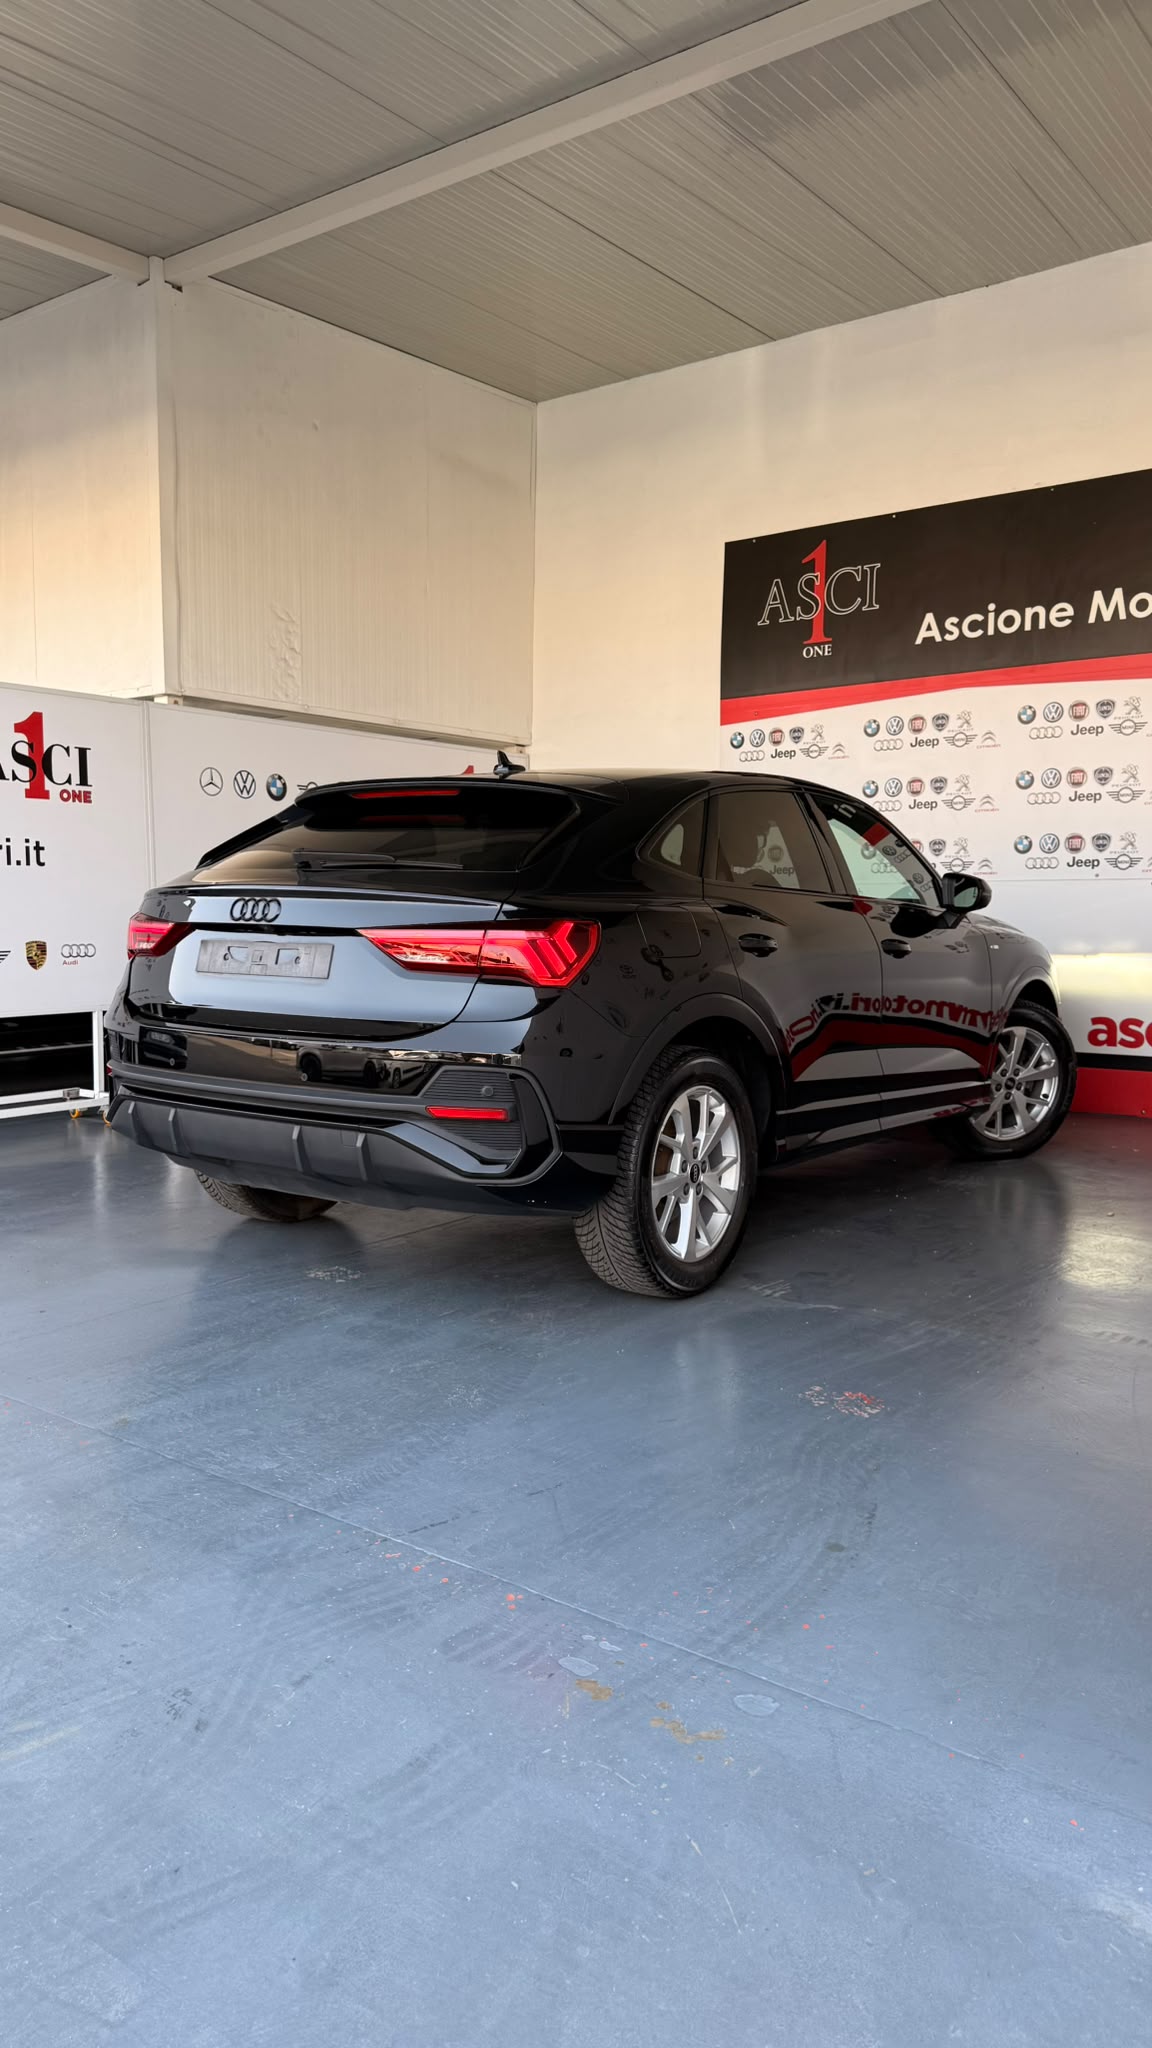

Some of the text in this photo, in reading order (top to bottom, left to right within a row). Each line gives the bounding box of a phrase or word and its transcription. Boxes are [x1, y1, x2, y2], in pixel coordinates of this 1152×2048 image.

[915, 602, 1075, 645] Ascione
[802, 644, 832, 659] ONE
[1070, 724, 1104, 736] Jeep
[910, 737, 939, 748] Jeep
[770, 748, 796, 759] Jeep
[59, 788, 92, 804] ONE
[1068, 790, 1102, 803] Jeep
[908, 799, 938, 811] Jeep
[0, 837, 46, 867] i.it
[1066, 856, 1100, 869] Jeep
[769, 865, 795, 877] Jeep
